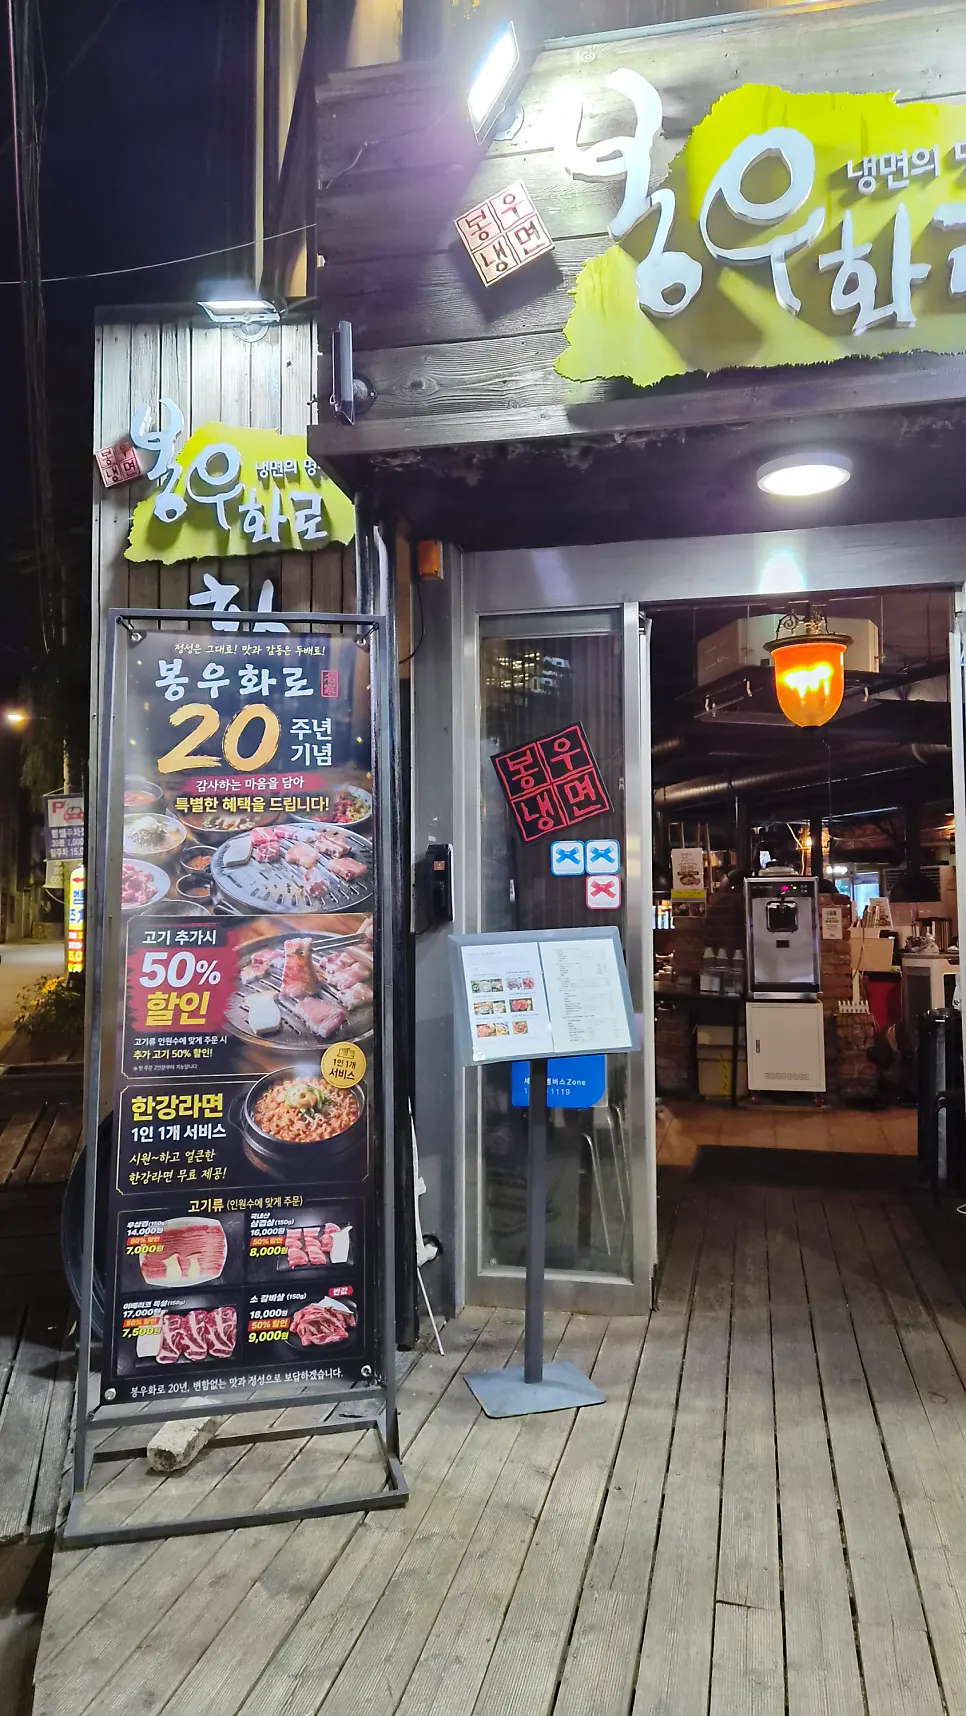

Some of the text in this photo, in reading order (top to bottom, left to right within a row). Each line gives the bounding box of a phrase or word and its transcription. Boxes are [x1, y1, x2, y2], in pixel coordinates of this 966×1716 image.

[847, 144, 939, 194] 냉면의
[130, 398, 328, 542] 봉우화로
[256, 460, 297, 478] 냉면의
[175, 644, 325, 656] 정성은 그대로! 맛과 감동은 두배로!
[155, 659, 314, 701] 봉우화로
[290, 718, 333, 741] 주년
[157, 703, 281, 774] 20
[291, 744, 333, 766] 기념
[506, 737, 581, 789] 봉우
[196, 776, 304, 792] 감사하는 마음을 담아
[52, 802, 64, 814] P
[175, 797, 330, 812] 특별한 혜택을 드립니다!
[520, 774, 602, 831] 냉면
[142, 930, 217, 945] 고기 추가시
[139, 951, 221, 988] 50%
[145, 992, 211, 1026] 할인
[133, 1036, 228, 1046] 고기류 인원수에 맞게 주문 시
[133, 1048, 213, 1060] 추가 고기 50% 할인!
[333, 1059, 356, 1069] 1인 1개
[329, 1068, 355, 1080] 서비스
[567, 1078, 586, 1086] Zone
[131, 1093, 223, 1121] 한강라면
[131, 1123, 227, 1142] 1인 1개 서비스
[129, 1149, 216, 1166] 시원~하고 얼큰한
[128, 1167, 227, 1185] 한강라면 무료 제공!
[188, 1195, 303, 1212] 고기류 (인원수에 맞게 주문)
[249, 1295, 258, 1303] 소
[260, 1293, 285, 1302] 갈비살
[250, 1309, 288, 1319] 18,000원
[251, 1318, 288, 1329] 50% 할인
[248, 1330, 289, 1343] 9,000원
[130, 1385, 165, 1397] 봉우화로
[193, 1379, 226, 1391] 변함없는
[229, 1376, 246, 1388] 맛과
[248, 1373, 282, 1386] 정성으로
[284, 1367, 344, 1382] 보답하겠습니다.
